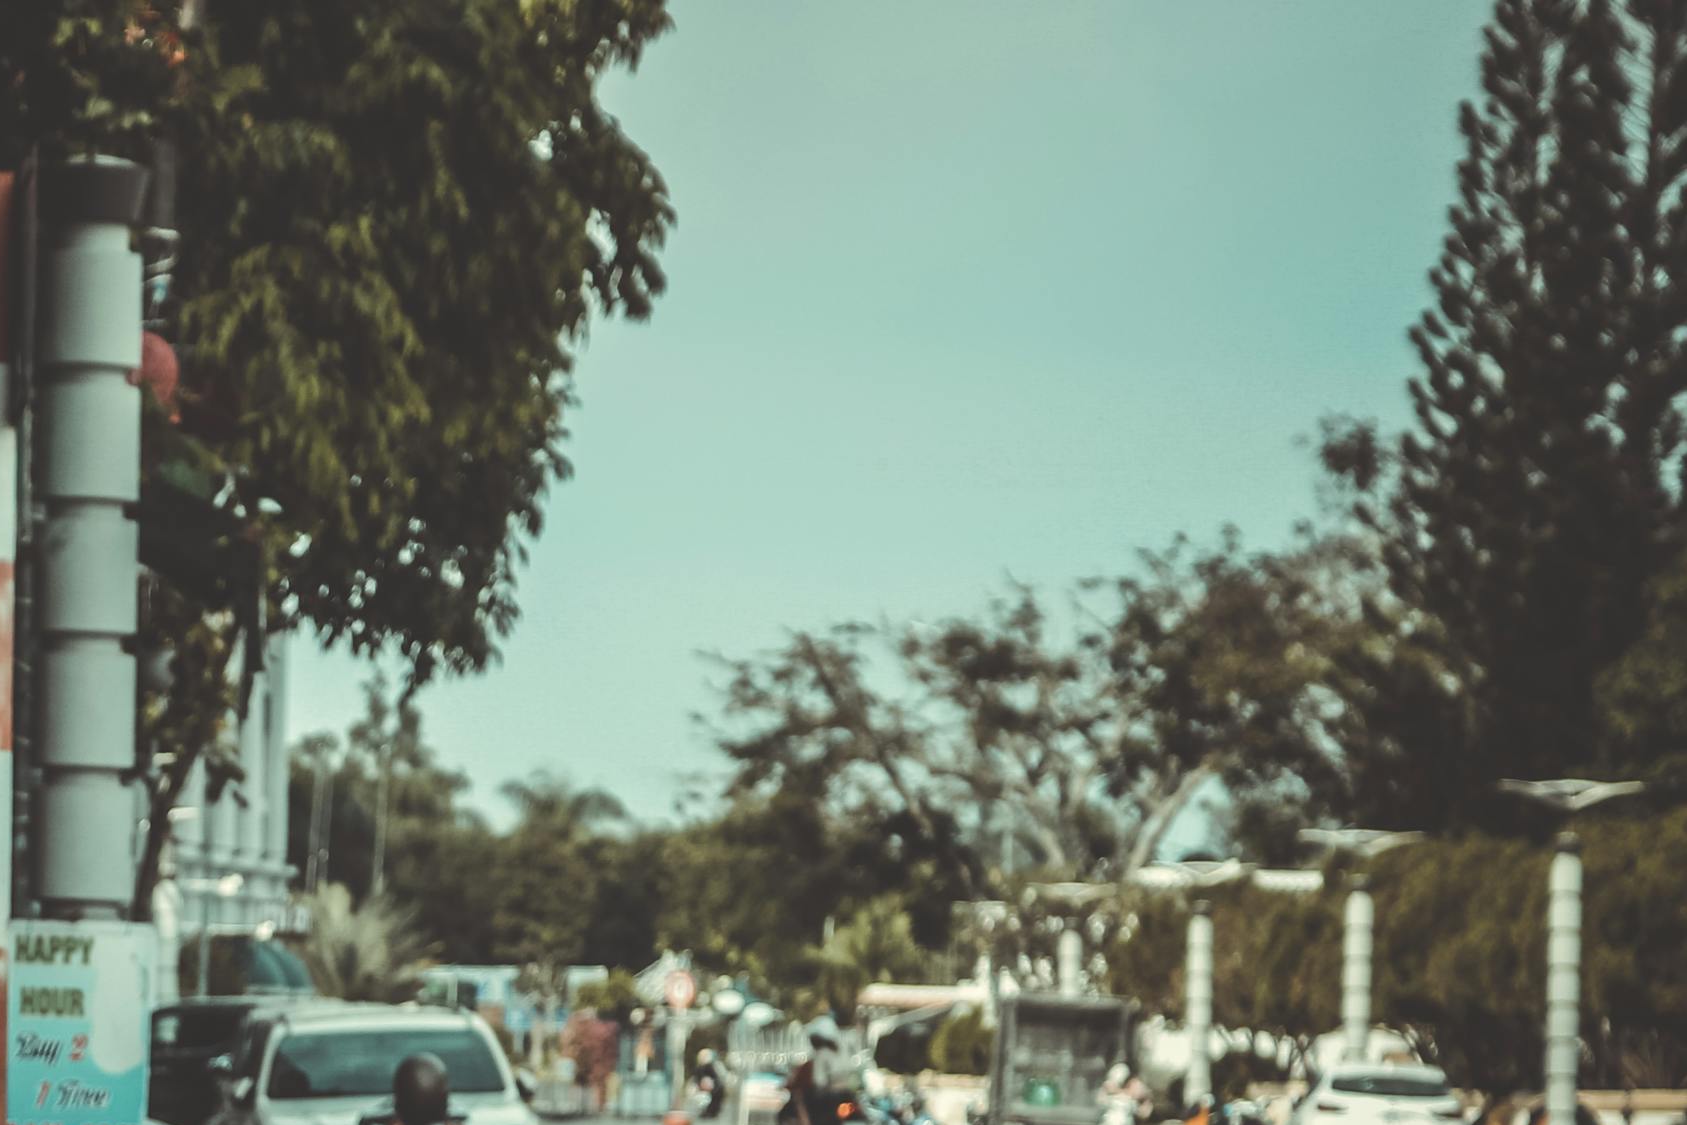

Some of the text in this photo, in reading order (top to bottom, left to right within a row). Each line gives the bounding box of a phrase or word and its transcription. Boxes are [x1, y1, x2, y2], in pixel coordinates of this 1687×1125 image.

[14, 936, 95, 965] HAPPY
[19, 987, 85, 1018] HOUR
[70, 1034, 88, 1061] 2
